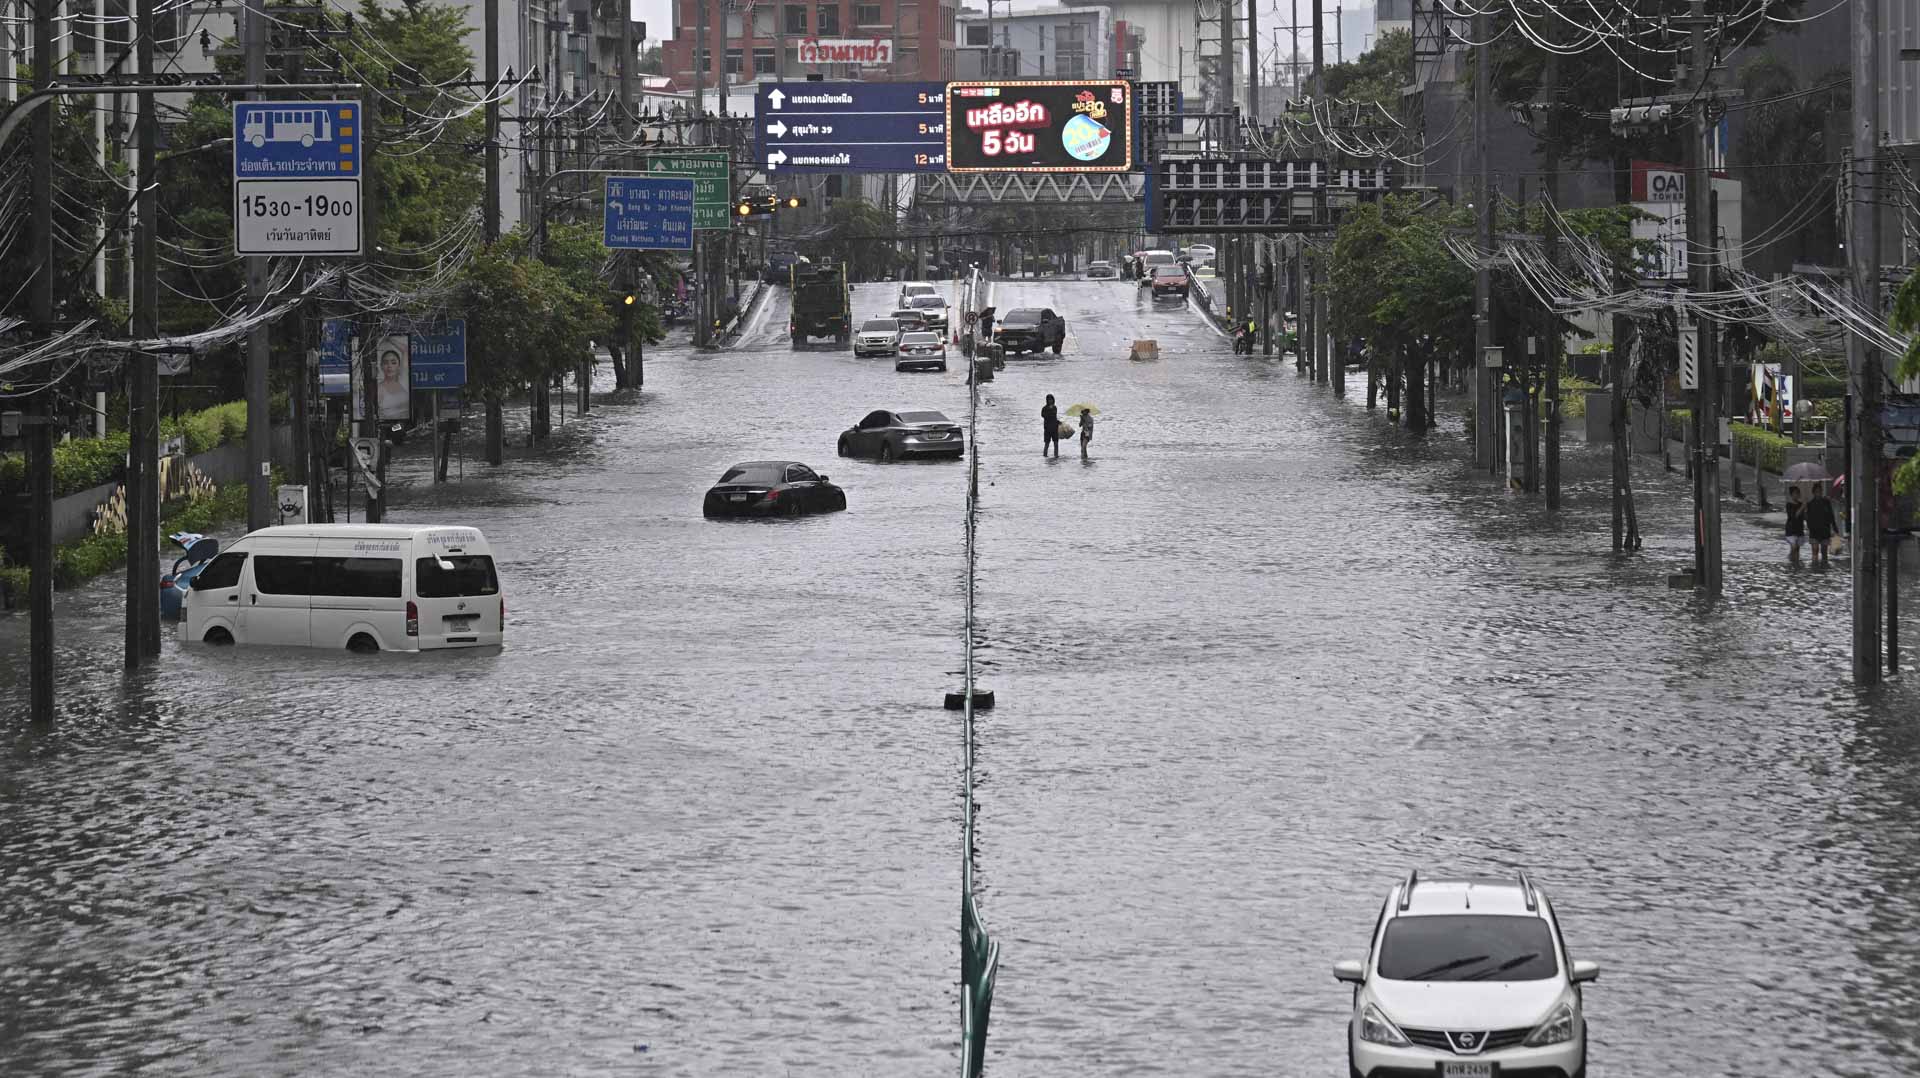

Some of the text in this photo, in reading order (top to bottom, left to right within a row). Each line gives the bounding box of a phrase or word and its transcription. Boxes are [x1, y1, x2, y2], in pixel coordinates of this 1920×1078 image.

[918, 93, 927, 104] 5
[928, 93, 944, 103] นาที
[967, 101, 1045, 127] เหลืออีก
[792, 123, 944, 137] สุขุมวิท 39 5 นาที
[983, 131, 1035, 155] 5 วัน
[792, 153, 944, 165] แยกทองหล่อใต้ 12 นาที
[1653, 175, 1684, 192] OAI
[266, 227, 332, 241] เว้นวันอาทิตย์
